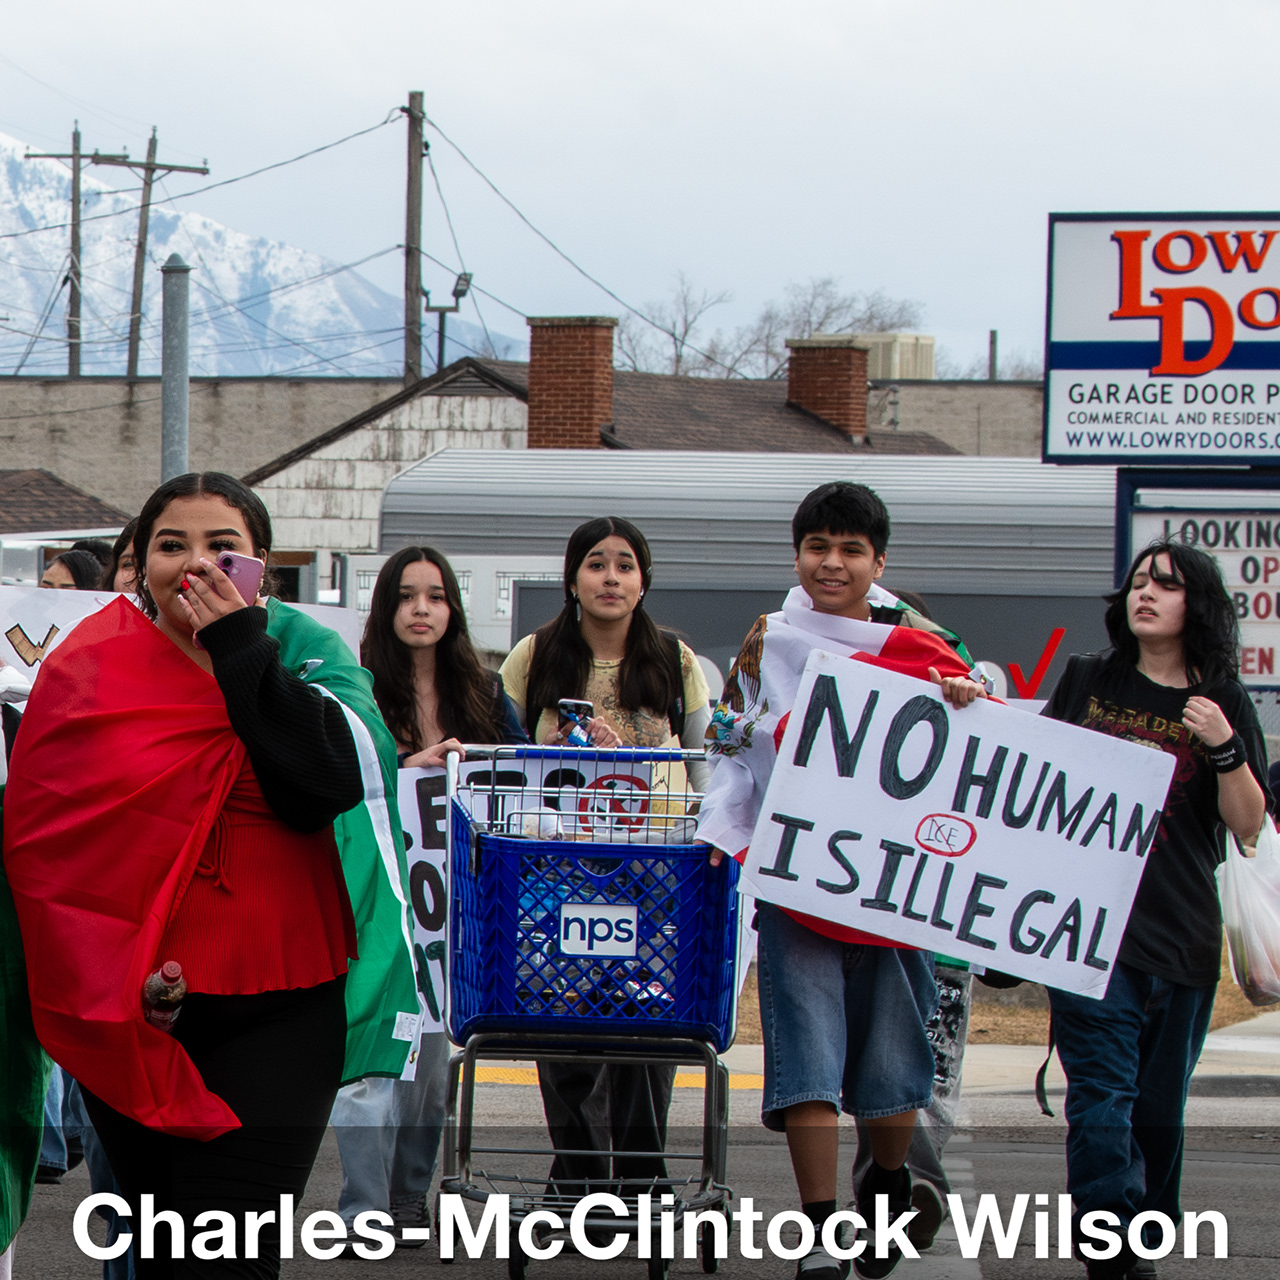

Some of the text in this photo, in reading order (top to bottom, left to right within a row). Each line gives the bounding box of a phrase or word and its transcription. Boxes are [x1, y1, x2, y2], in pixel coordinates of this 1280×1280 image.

[1068, 383, 1173, 405] GARAGE
[1184, 383, 1256, 405] DOOR
[1067, 411, 1169, 425] COMMERCIAL
[1175, 411, 1207, 425] AND
[1081, 695, 1209, 764] MEGADE
[793, 673, 1163, 860] NO HUMAN
[925, 818, 960, 847] ICE
[758, 812, 1111, 971] IS ILLEGAL
[563, 915, 635, 951] nps
